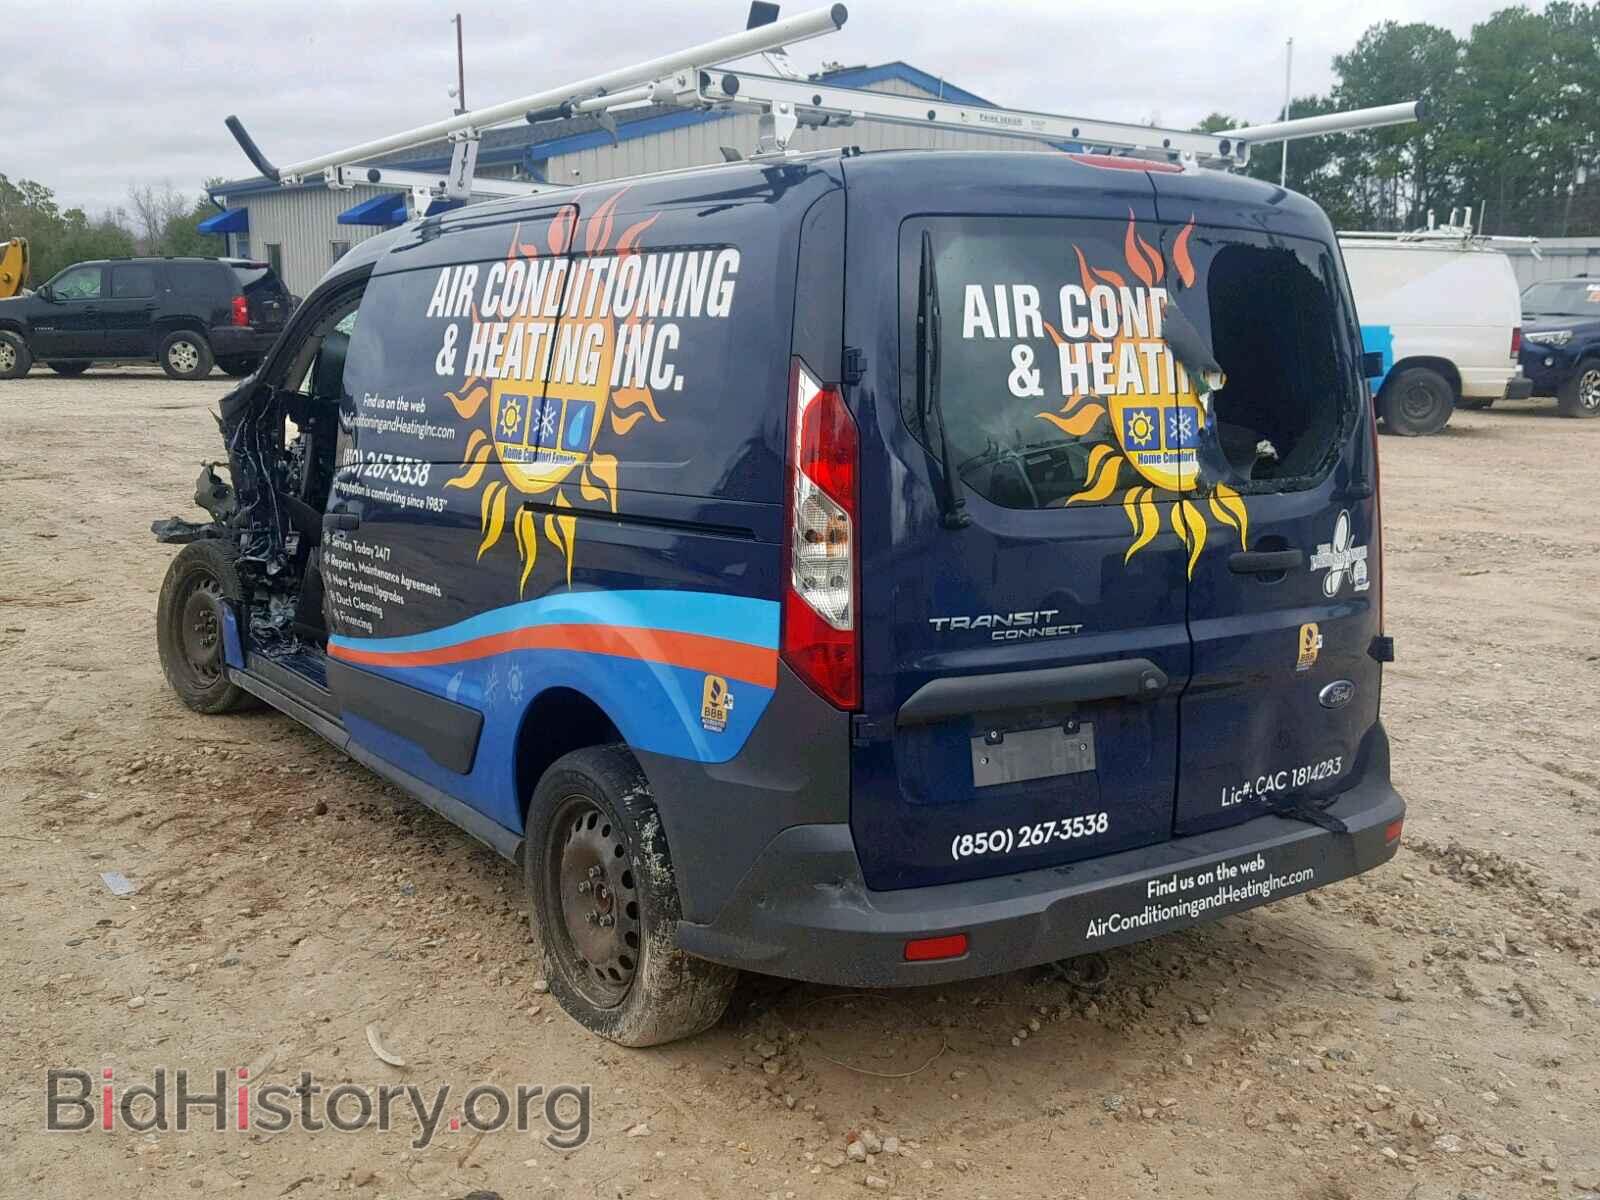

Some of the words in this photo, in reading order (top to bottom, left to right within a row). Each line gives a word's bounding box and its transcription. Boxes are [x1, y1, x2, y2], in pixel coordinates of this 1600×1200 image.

[426, 264, 480, 318] AIR
[480, 248, 741, 318] CONDITIONING
[962, 284, 1045, 339] AIR
[434, 323, 459, 376] &
[464, 322, 606, 385] HEATING
[609, 322, 685, 391] INC.
[1007, 344, 1045, 397] &
[363, 392, 378, 408] Find
[377, 399, 384, 408] us
[386, 400, 396, 411] on
[397, 395, 410, 412] the
[411, 397, 427, 414] web
[364, 451, 432, 488] 267-3538
[1137, 452, 1162, 466] Home
[406, 493, 425, 509] since
[353, 539, 375, 559] Today
[375, 545, 392, 562] 24/7
[333, 574, 349, 587] New
[349, 577, 375, 595] System
[374, 583, 405, 605] Upgrades
[401, 573, 443, 598] Agreements
[337, 591, 352, 608] Duct
[353, 596, 384, 620] Cleaning
[928, 609, 1060, 632] TRANSIT
[339, 610, 374, 635] Financing
[991, 624, 1084, 642] CONNECT
[1221, 780, 1254, 807] Lic#:
[1255, 770, 1288, 796] CAC
[1291, 756, 1343, 788] 1814283
[951, 828, 1014, 861] (850)
[1016, 812, 1109, 849] 267-3538
[1147, 874, 1178, 899] Find
[1179, 879, 1195, 890] us
[1197, 872, 1215, 887] on
[1216, 861, 1238, 882] the
[1240, 853, 1266, 874] web
[1085, 867, 1315, 939] AirConditioningandHeatingInc.com
